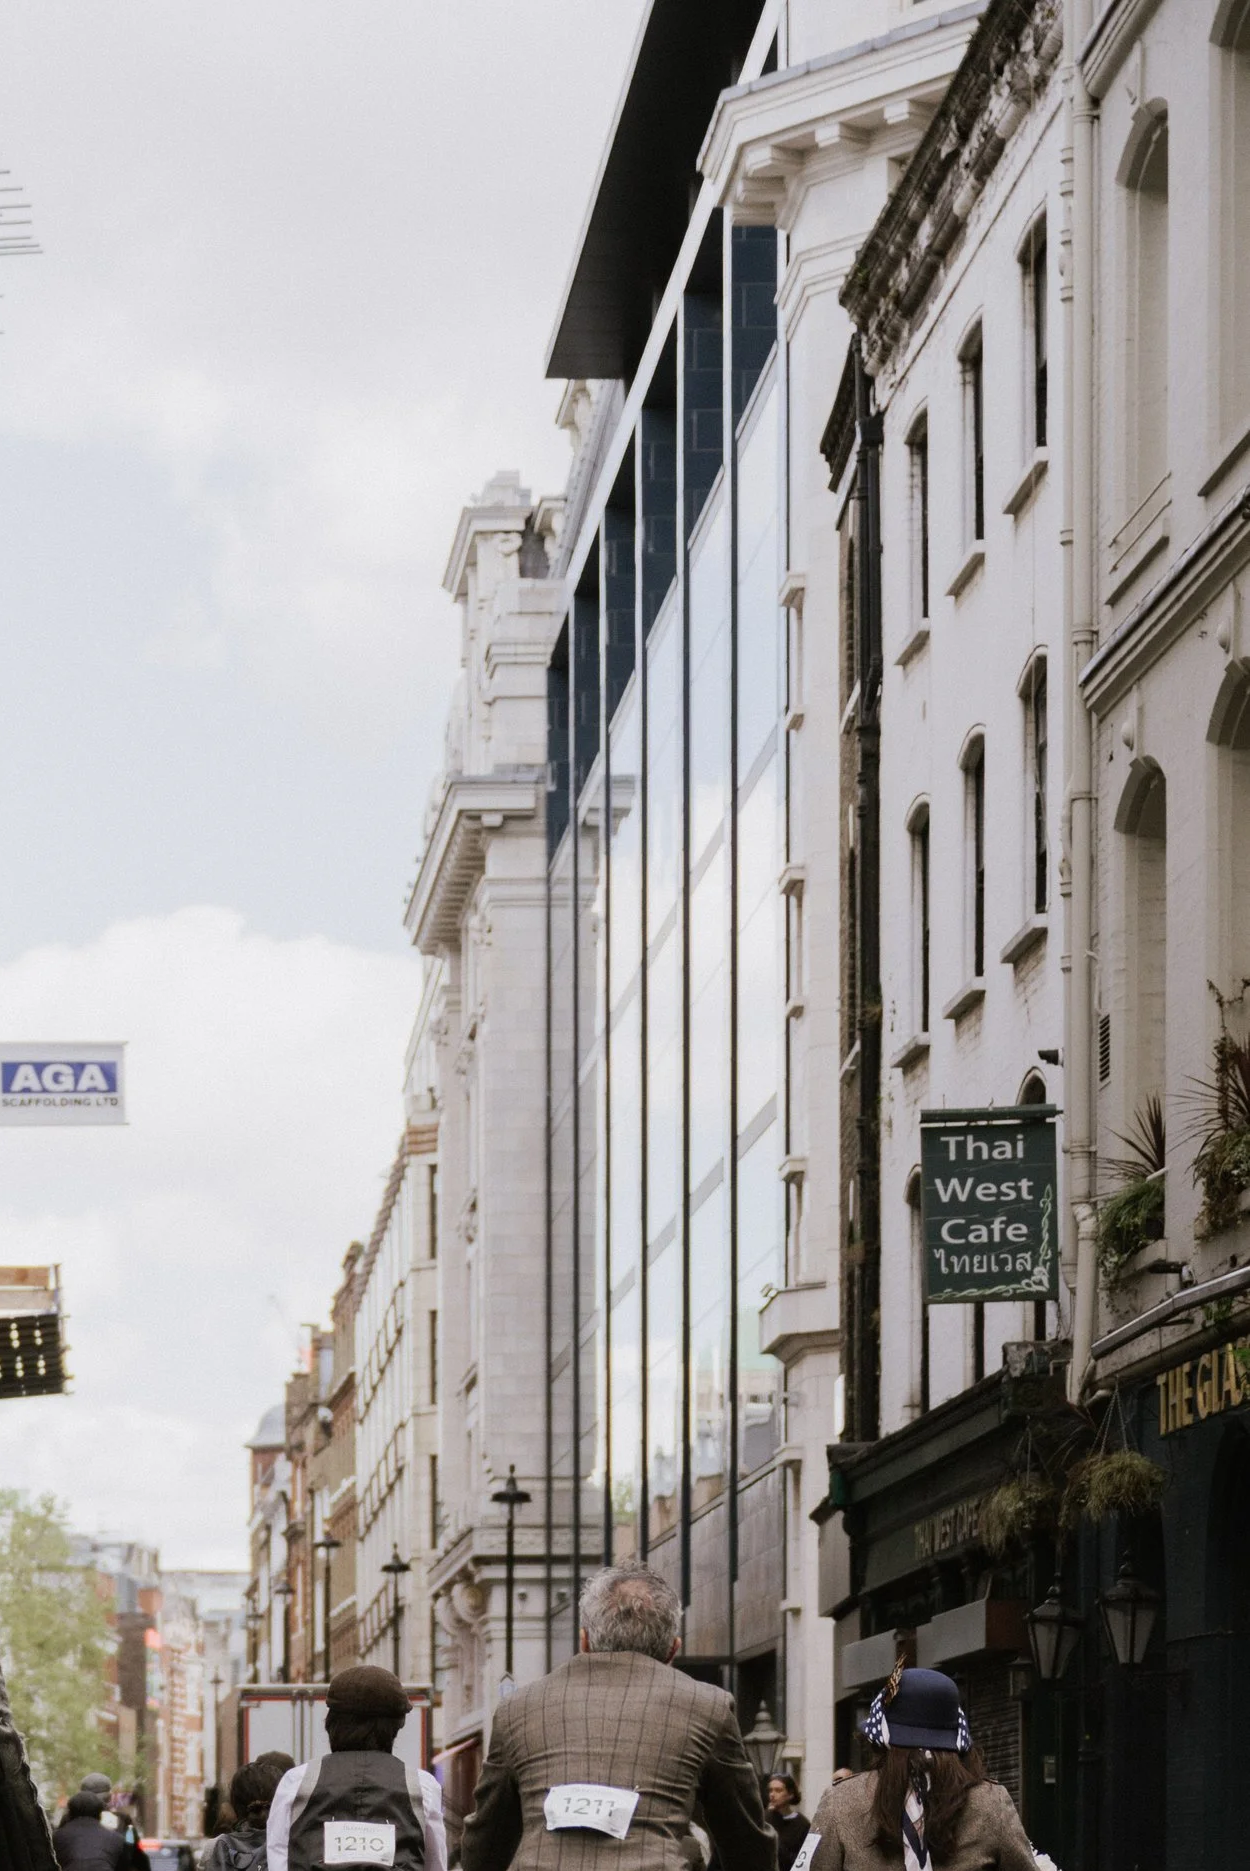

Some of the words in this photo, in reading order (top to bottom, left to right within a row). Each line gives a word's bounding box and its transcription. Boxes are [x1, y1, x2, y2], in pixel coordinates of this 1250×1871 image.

[10, 1063, 110, 1093] AGA
[1, 1097, 91, 1108] SCAFFOLDING
[95, 1097, 119, 1107] LTD
[940, 1134, 1025, 1161] Thai
[934, 1177, 1034, 1203] West
[940, 1216, 1029, 1244] Cafe
[1156, 1361, 1194, 1436] THE
[563, 1797, 616, 1818] 1211
[334, 1836, 385, 1852] 1210
